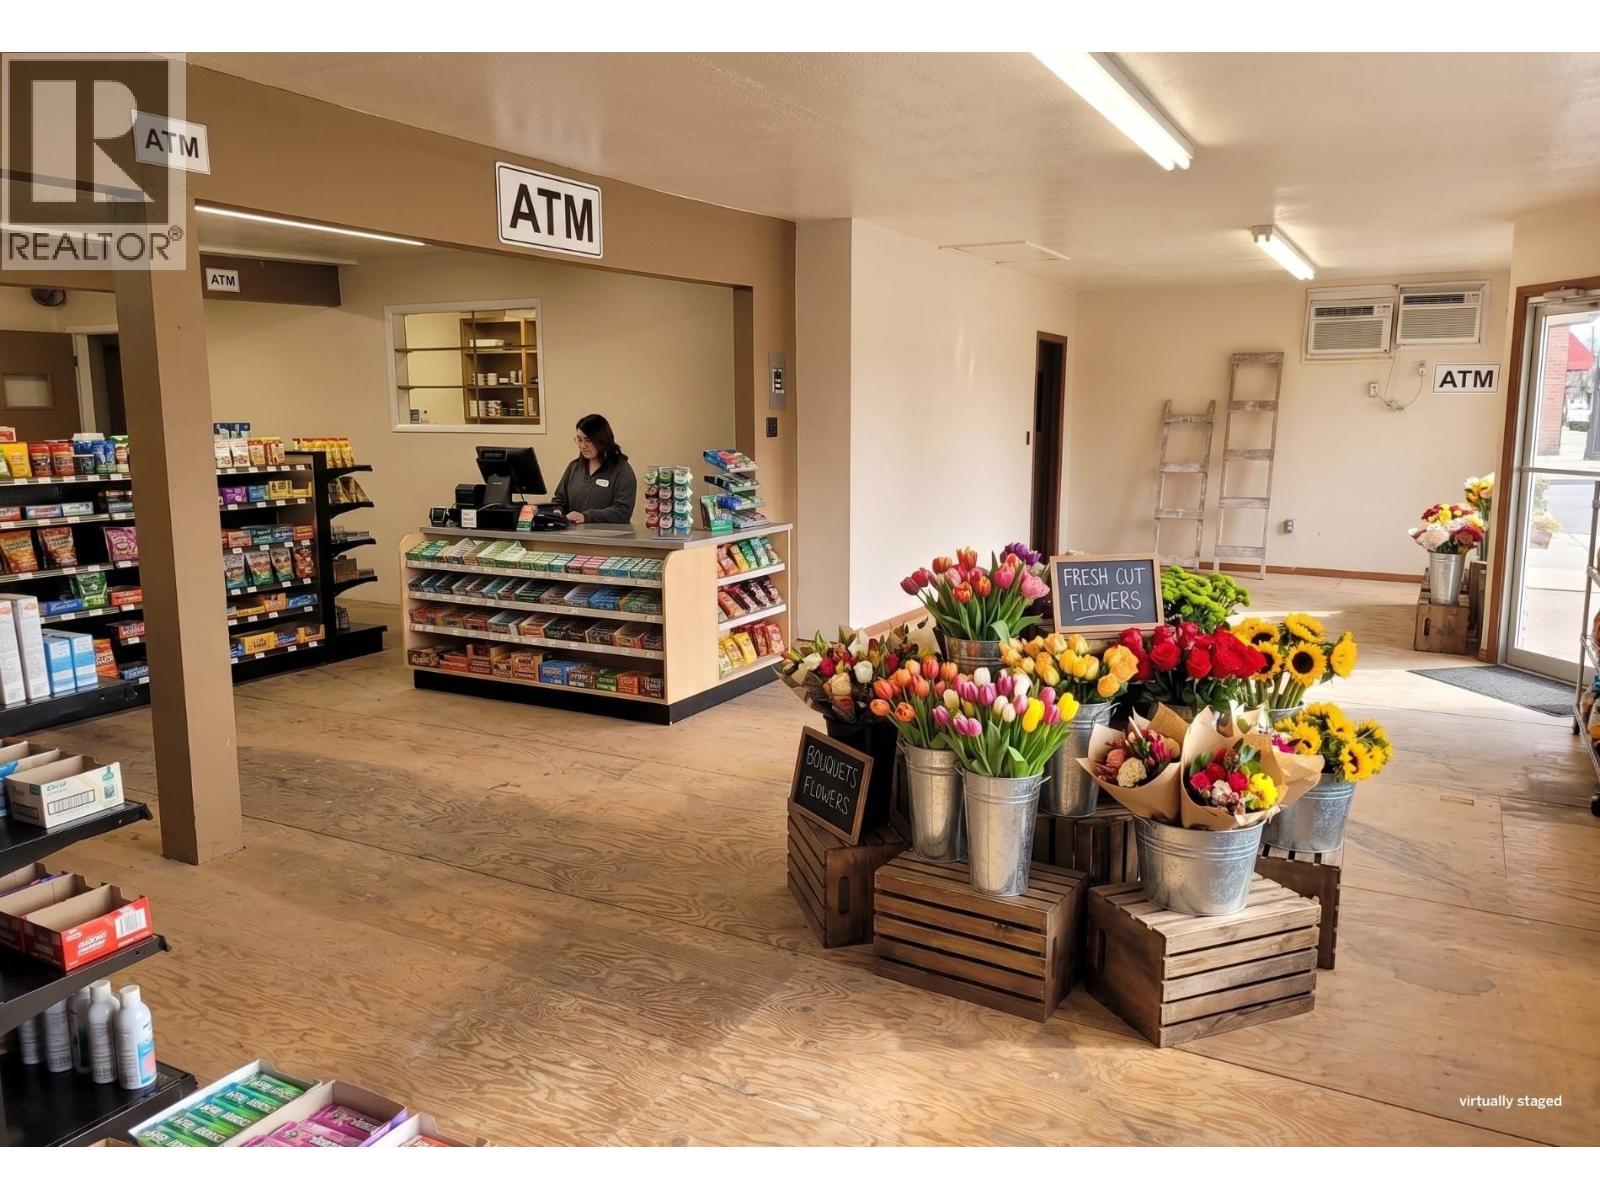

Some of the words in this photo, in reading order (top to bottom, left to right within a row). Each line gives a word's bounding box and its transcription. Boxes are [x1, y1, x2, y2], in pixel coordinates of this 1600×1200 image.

[145, 127, 200, 159] ATM
[509, 183, 594, 243] ATM
[211, 274, 236, 287] ATM
[1438, 369, 1494, 388] ATM
[1063, 567, 1109, 587] FRESH
[1115, 567, 1147, 585] CUT
[1069, 590, 1142, 612] FLOWERS
[806, 745, 859, 789] BOUQUETS
[802, 775, 851, 815] FLOWERS
